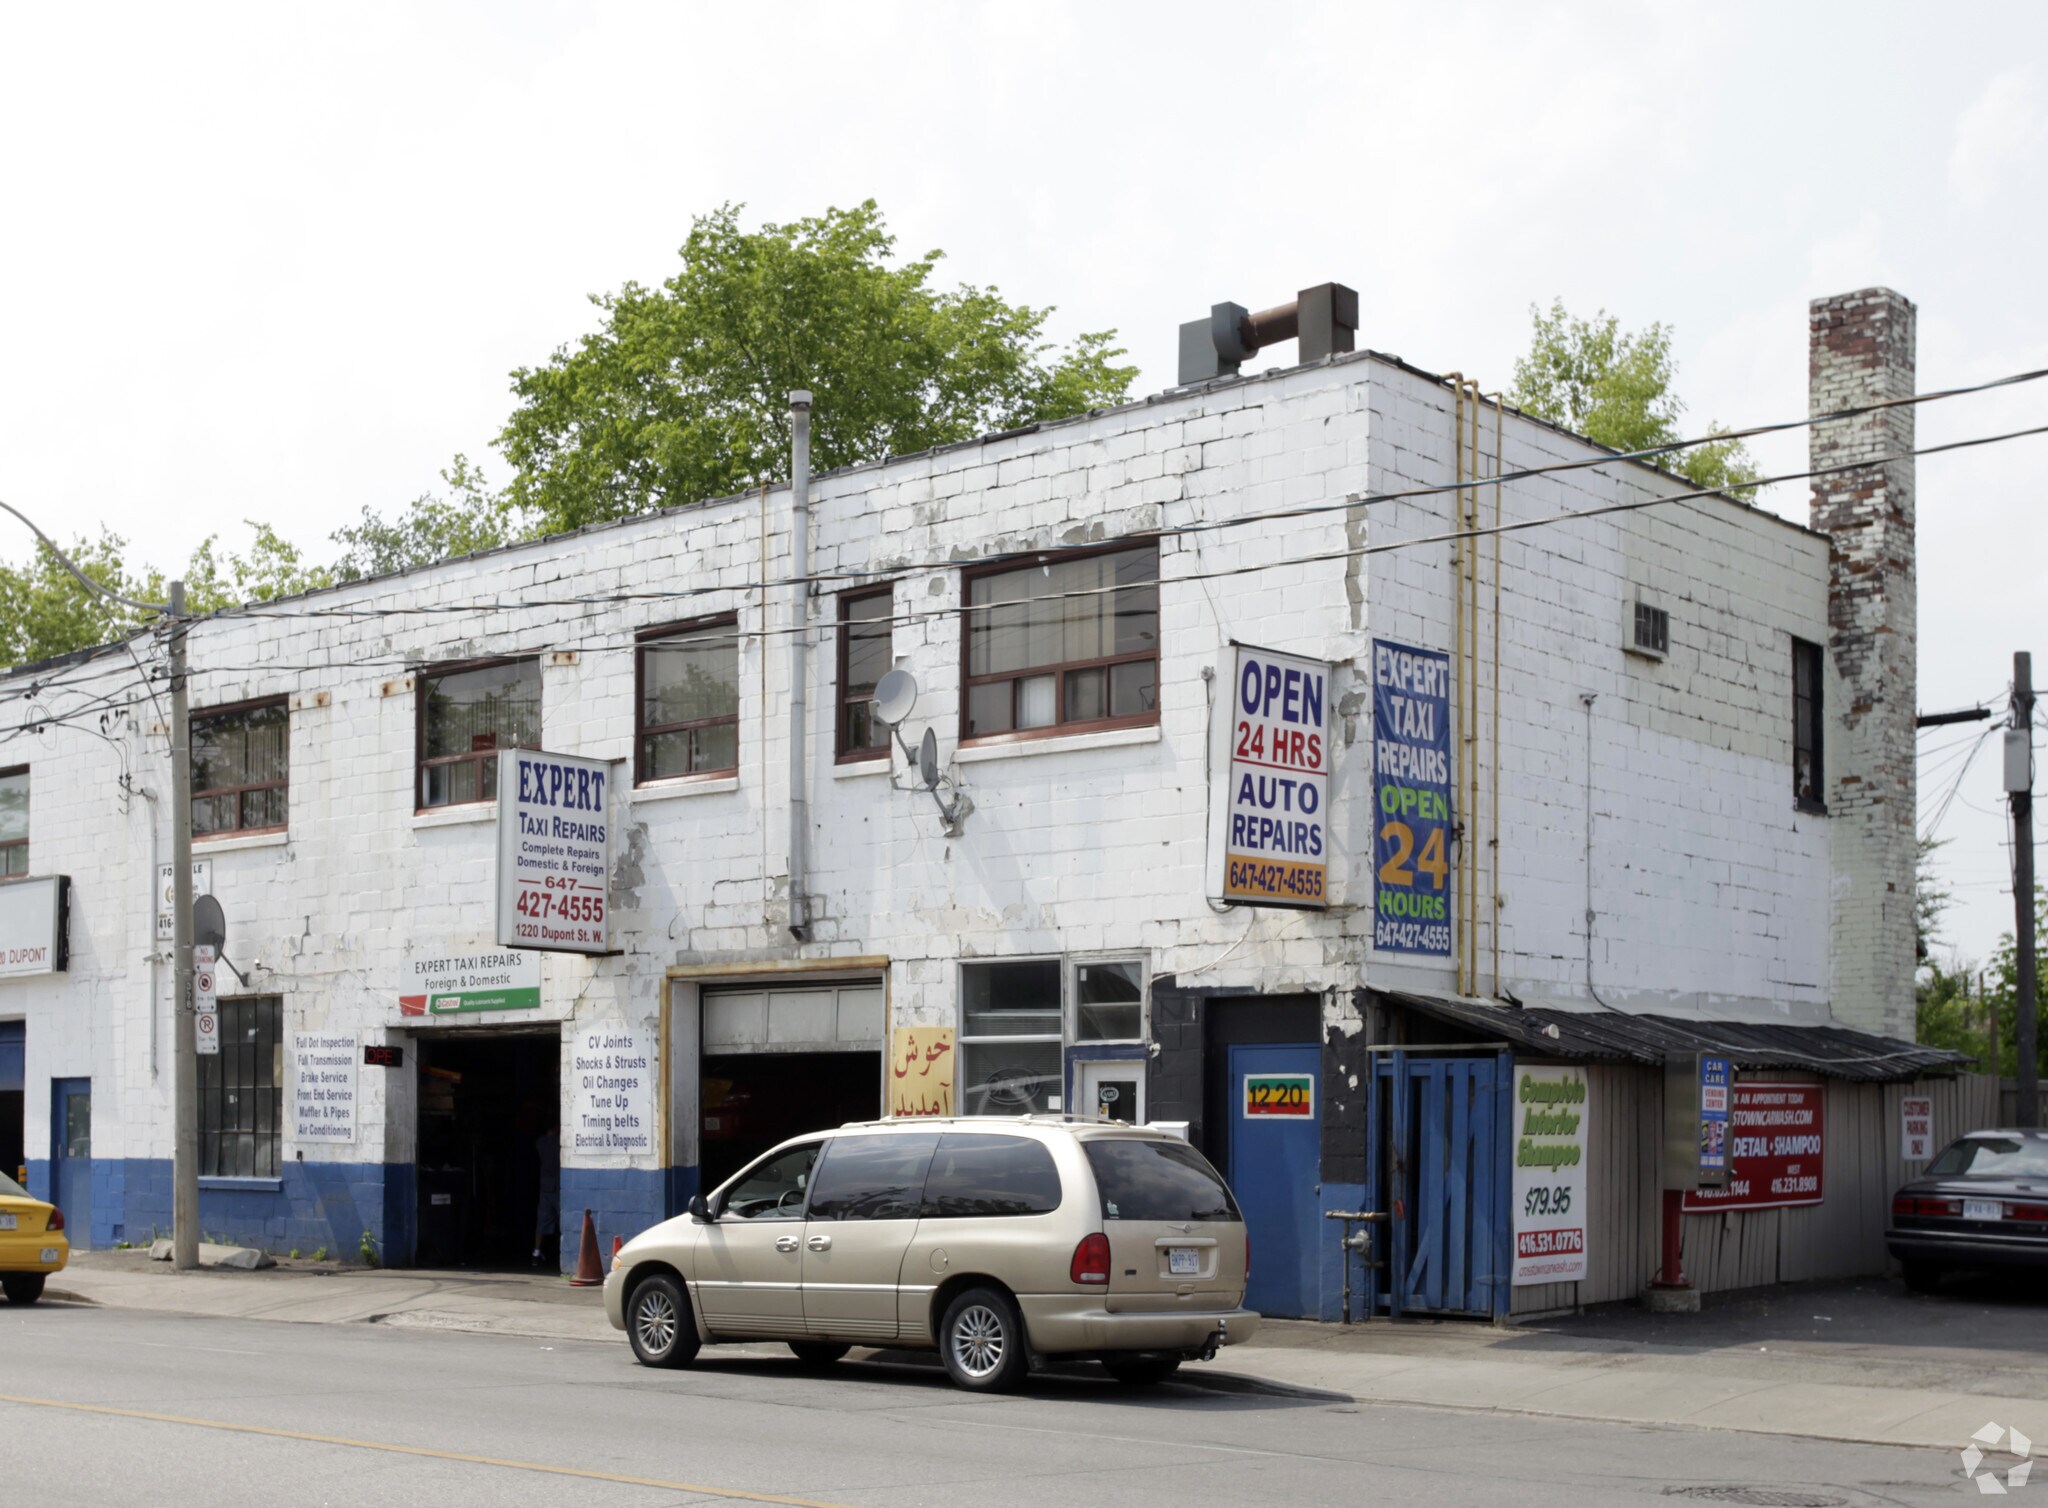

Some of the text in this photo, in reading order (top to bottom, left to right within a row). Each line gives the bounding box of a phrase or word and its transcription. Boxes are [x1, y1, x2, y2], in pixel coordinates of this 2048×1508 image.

[1376, 645, 1448, 698] EXPERT
[1241, 660, 1323, 728] OPEN
[1391, 695, 1434, 741] TAXI
[1236, 721, 1321, 769] 24 HRS
[1378, 739, 1447, 785] REPAIRS
[518, 760, 604, 812] EXPERT
[1237, 772, 1319, 815] AUTO
[1381, 785, 1448, 821] OPEN
[519, 812, 605, 843] TAXI REPAIRS
[1232, 813, 1322, 856] REPAIRS
[522, 841, 600, 860] Complete Repairs
[1379, 821, 1448, 890] 24
[162, 864, 203, 877] FO LE
[517, 856, 604, 877] Domestic & Foreign
[545, 876, 578, 891] 647
[1230, 861, 1322, 896] 647-427-4555
[517, 890, 603, 923] 427-4555
[1379, 890, 1445, 920] HOURS
[516, 923, 604, 944] 1220 Dupont St. W.
[1377, 921, 1449, 950] 647-427-4555
[9, 947, 47, 964] DUPONT
[415, 953, 522, 974] EXPERT TAXI REPAIRS
[425, 972, 511, 991] Foreign & Domestic
[296, 1037, 355, 1050] Full Dot Inspection
[588, 1035, 633, 1049] CV Joints
[298, 1054, 352, 1066] Full Transmission
[576, 1057, 603, 1070] Shocks
[606, 1056, 611, 1069] &
[895, 1034, 950, 1078] خوش
[1706, 1060, 1723, 1072] CAR
[301, 1072, 348, 1083] Brake Service
[583, 1075, 639, 1092] Oil Changes
[1705, 1074, 1725, 1084] CARE
[297, 1089, 353, 1101] Front End Service
[1249, 1083, 1303, 1108] 1220
[1519, 1074, 1585, 1109] Complete
[1704, 1088, 1725, 1098] VENDING
[1740, 1093, 1750, 1105] AN
[1751, 1093, 1786, 1105] APPOINTMENT
[1787, 1093, 1805, 1105] TODAY
[590, 1094, 629, 1111] Tune Up
[1705, 1099, 1724, 1109] CENTER
[1904, 1101, 1930, 1116] CUSTOMER
[299, 1106, 350, 1120] Muffler & Pipes
[582, 1114, 640, 1131] Timing belts
[1522, 1107, 1581, 1135] Interior
[1732, 1110, 1813, 1126] STOWNCARWASH.COM
[298, 1123, 352, 1139] Air Conditioning
[1906, 1120, 1928, 1136] PARKING
[576, 1133, 647, 1151] Electrical & Diagnostic
[1733, 1137, 1769, 1157] DETAIL
[1774, 1135, 1821, 1156] SHAMPOO
[1911, 1140, 1924, 1155] ONLY
[1517, 1138, 1581, 1173] Shampoo
[1525, 1186, 1572, 1218] $79.95
[1519, 1231, 1582, 1254] 416.531.0776
